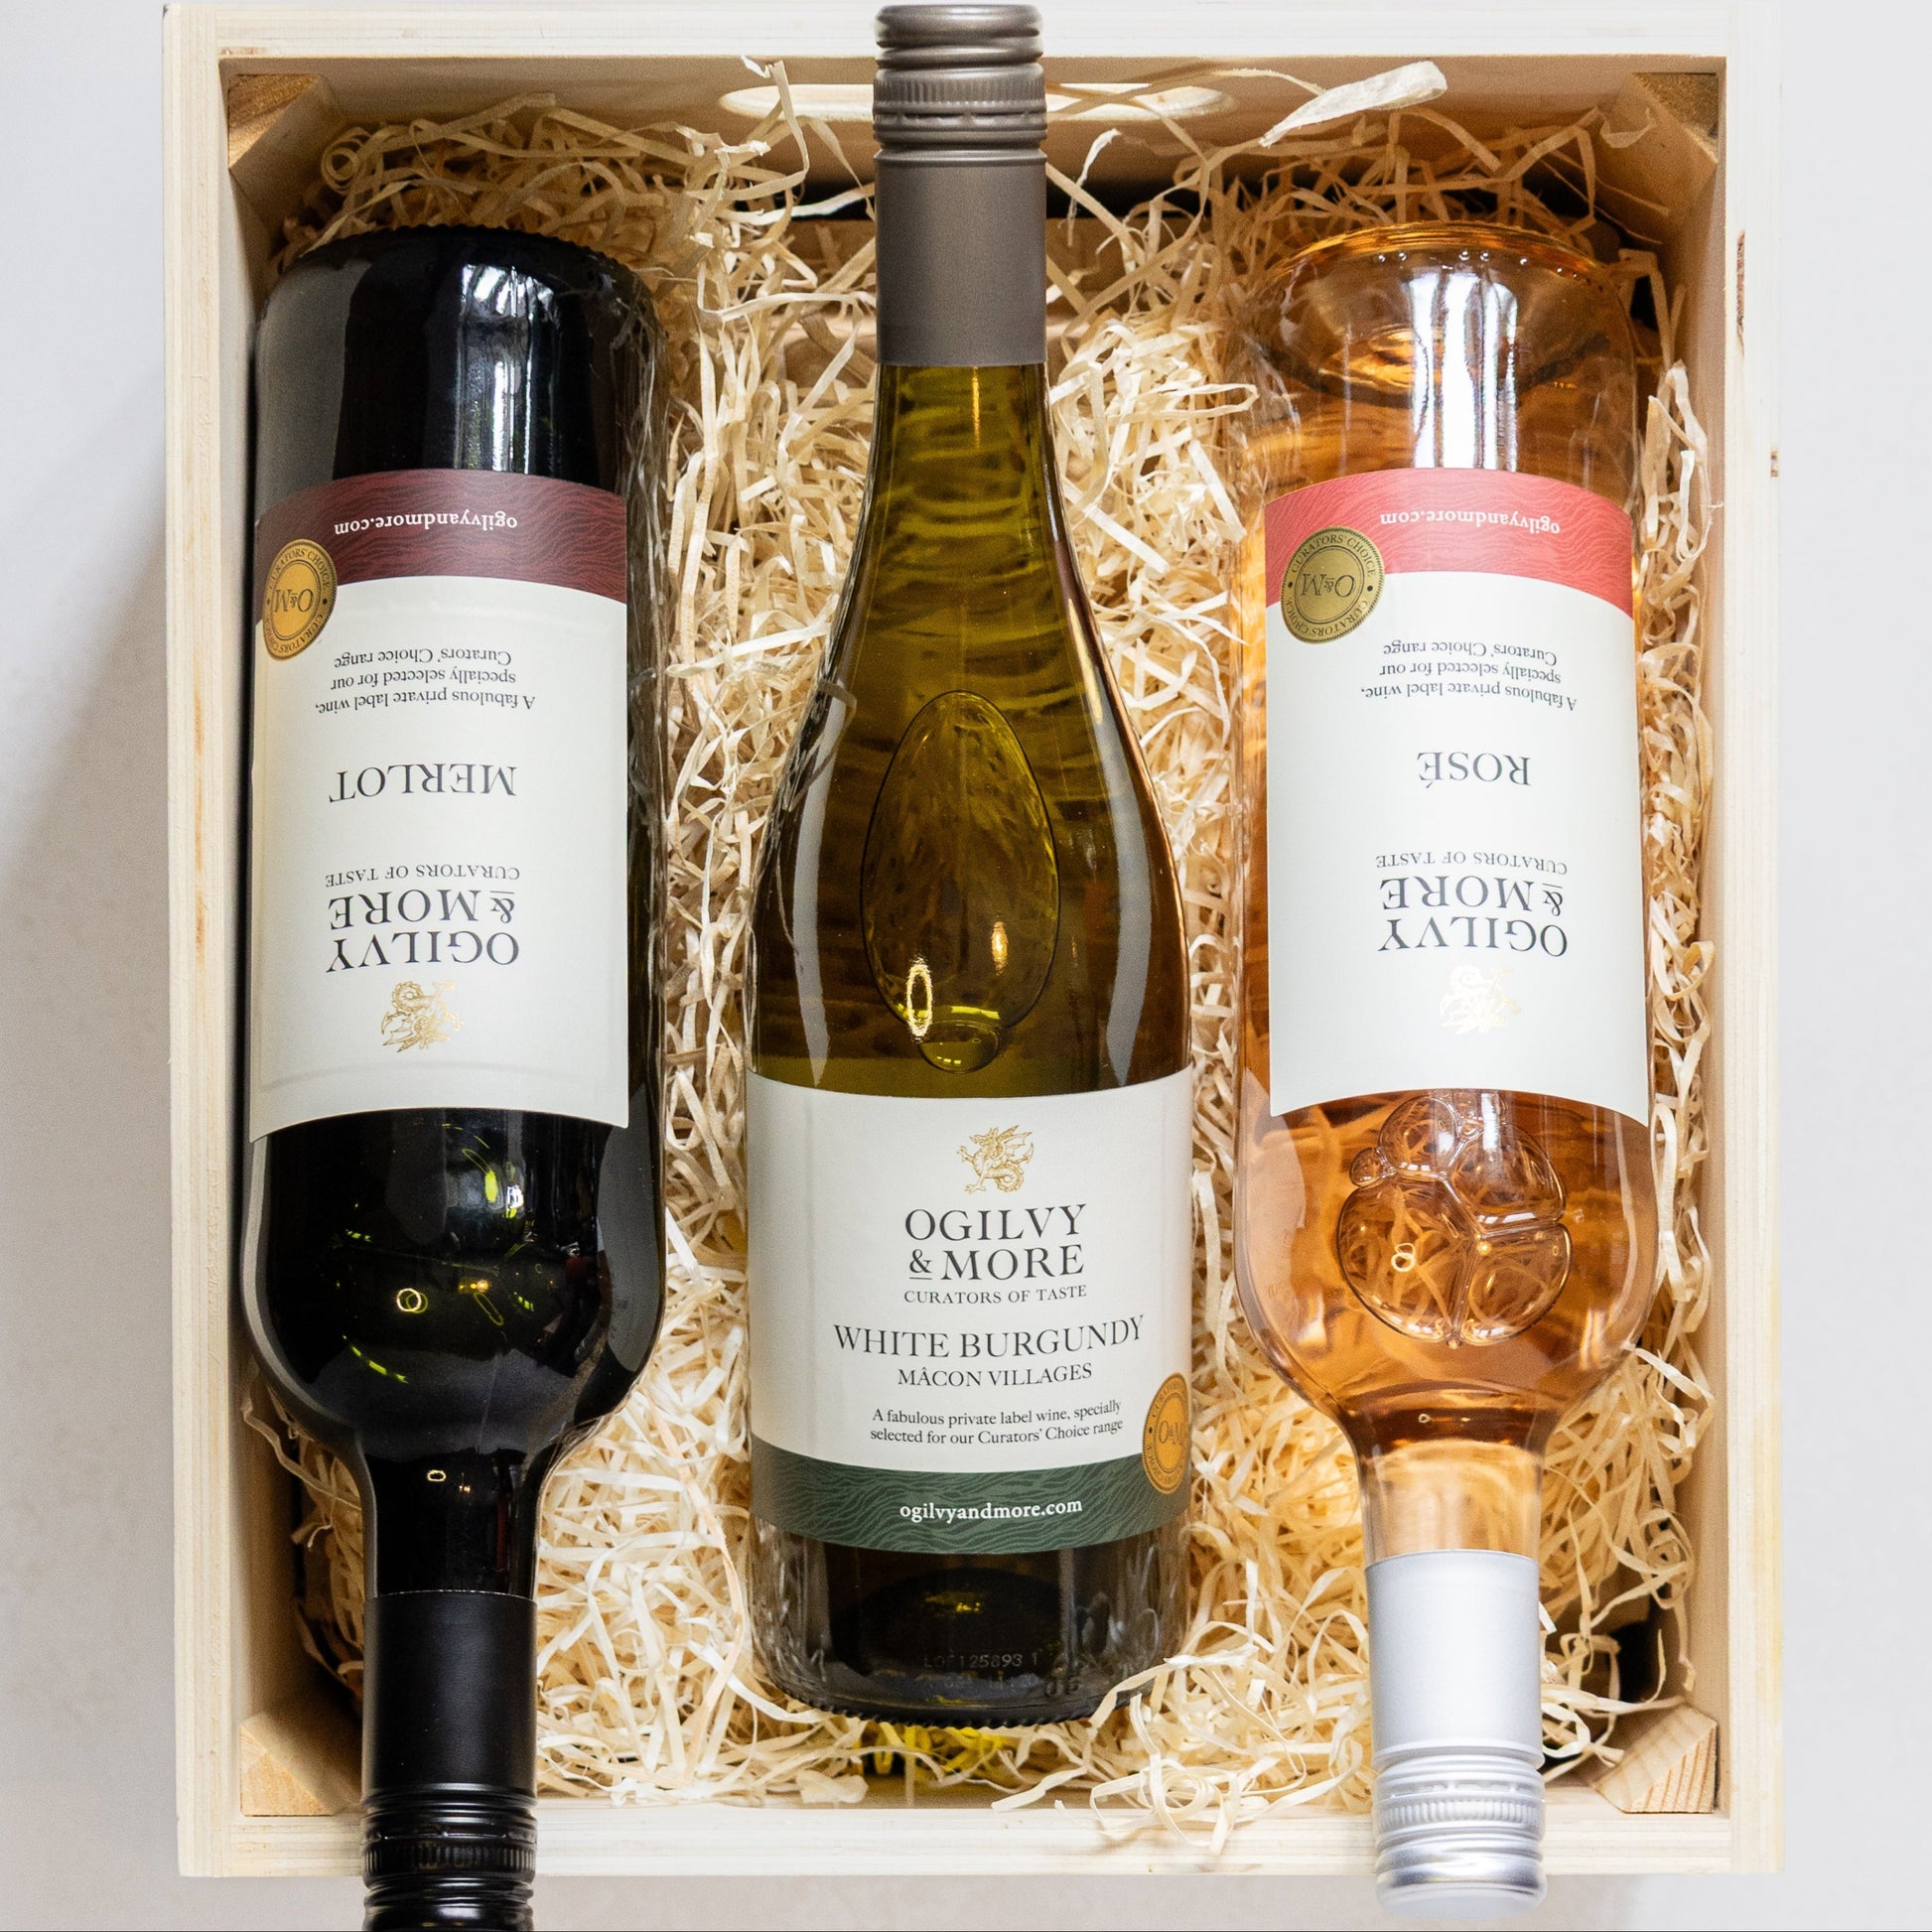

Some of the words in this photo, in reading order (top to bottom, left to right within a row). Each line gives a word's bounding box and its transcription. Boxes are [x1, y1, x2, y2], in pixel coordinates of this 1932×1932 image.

[334, 509, 518, 534] ogilvyandmore.com
[1380, 510, 1561, 535] ogilvyandmore.com
[377, 648, 434, 663] Choice
[1384, 639, 1427, 655] range
[1432, 641, 1487, 657] Choice
[1491, 643, 1558, 667] Curators'
[334, 651, 373, 668] range
[439, 648, 512, 667] Curators'
[383, 669, 446, 686] selected
[450, 665, 516, 684] specially
[1379, 663, 1406, 676] our
[1410, 662, 1432, 676] for
[1438, 662, 1498, 675] selected
[1503, 661, 1562, 684] specially
[331, 677, 354, 691] our
[357, 672, 378, 688] for
[1448, 681, 1501, 697] private
[393, 687, 448, 705] private
[1361, 685, 1402, 699] wine,
[1408, 682, 1443, 697] label
[1505, 685, 1564, 709] fabulous
[316, 699, 350, 715] wine,
[353, 694, 389, 711] label
[453, 691, 519, 709] fabulous
[522, 695, 536, 710] A
[1567, 697, 1578, 712] A
[1416, 752, 1532, 788] ROSÉ
[329, 762, 517, 803] MERLOT
[1376, 852, 1436, 869] TASTE
[1442, 851, 1466, 865] OF
[1473, 852, 1568, 876] CURATORS
[326, 868, 379, 888] TASTE
[385, 866, 409, 880] OF
[415, 864, 520, 881] CURATORS
[1377, 915, 1568, 957] OGILVY
[326, 930, 520, 974] OGILVY
[905, 1203, 1087, 1242] OGILVY
[903, 1290, 1002, 1305] CURATORS
[1008, 1289, 1031, 1304] OF
[1036, 1285, 1087, 1302] TASTE
[833, 1324, 950, 1358] WHITE
[959, 1314, 1145, 1358] BURGUNDY
[897, 1366, 982, 1387] MÂCON
[987, 1362, 1093, 1386] VILLAGES
[872, 1408, 884, 1422] A
[888, 1410, 944, 1425] fabulous
[948, 1412, 997, 1429] private
[1001, 1410, 1033, 1425] label
[1036, 1408, 1071, 1423] wine,
[1074, 1400, 1122, 1421] specially
[870, 1428, 923, 1444] selected
[927, 1430, 947, 1445] for
[950, 1434, 975, 1445] our
[978, 1428, 1043, 1445] Curators'
[1045, 1426, 1090, 1441] Choice
[1093, 1418, 1124, 1435] range
[899, 1497, 1083, 1524] ogilvyandmore.com
